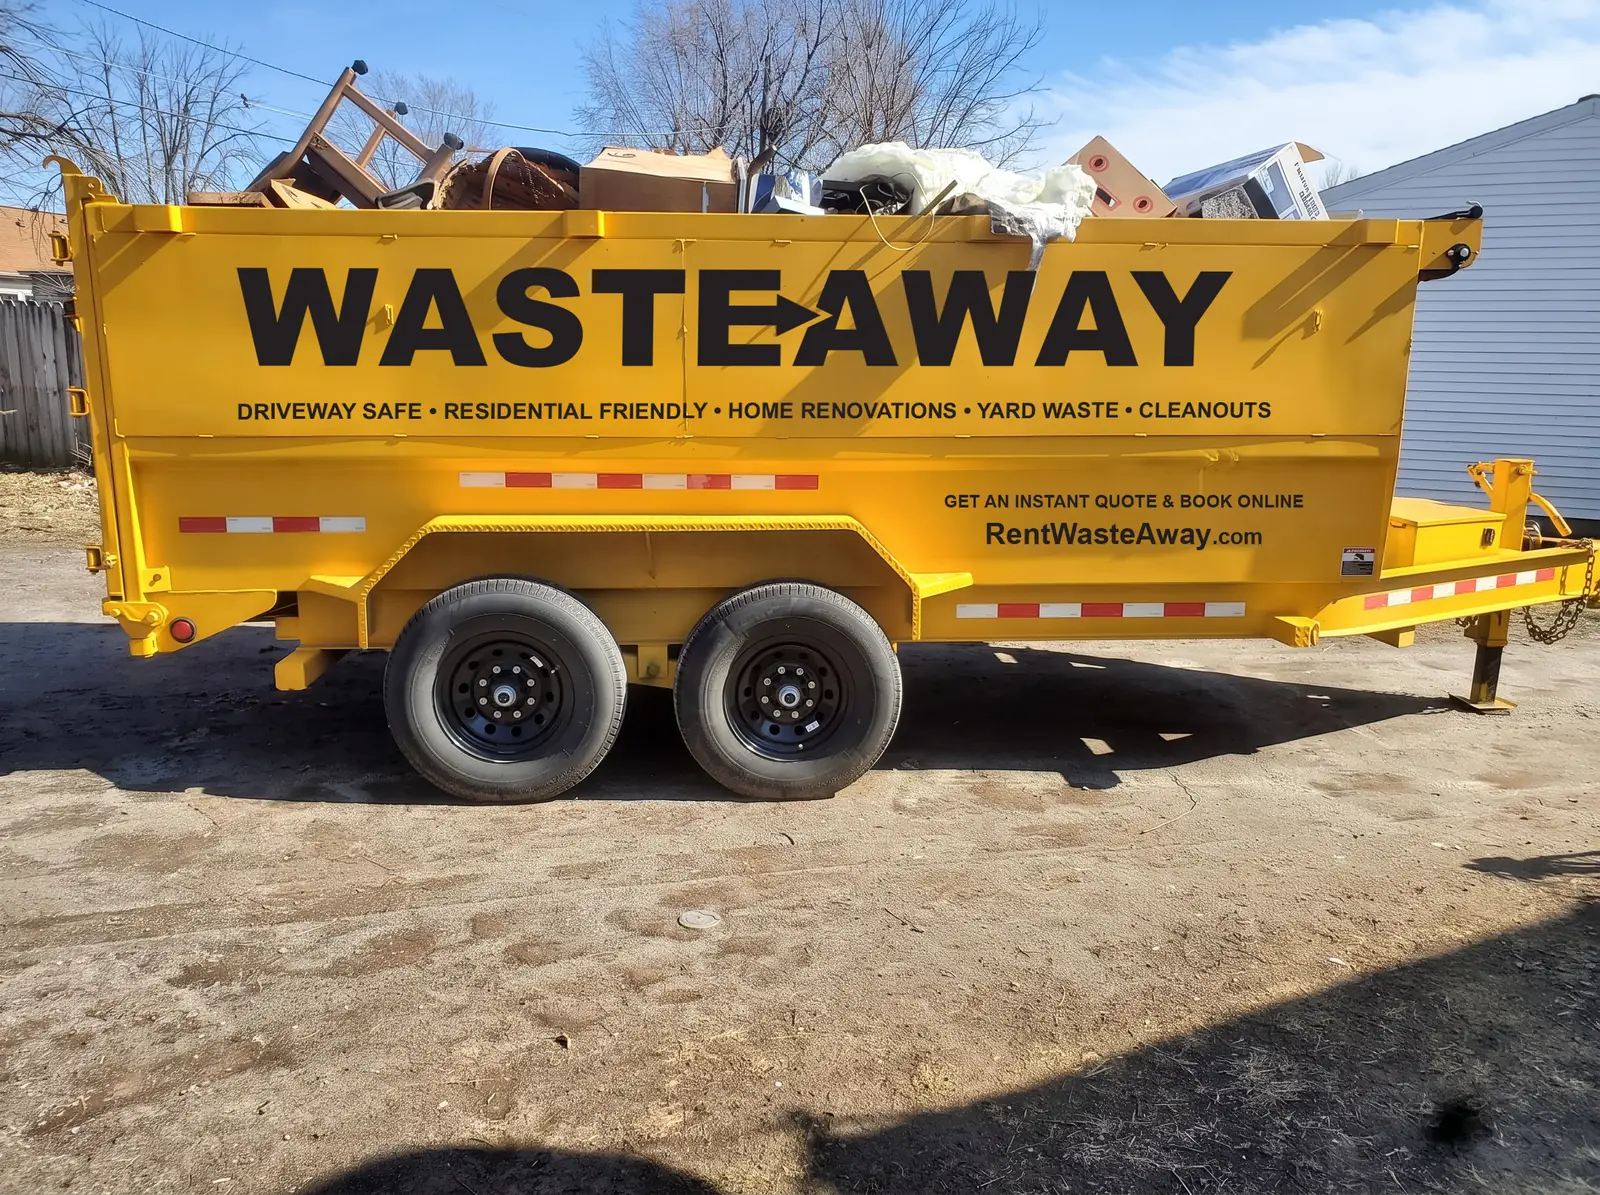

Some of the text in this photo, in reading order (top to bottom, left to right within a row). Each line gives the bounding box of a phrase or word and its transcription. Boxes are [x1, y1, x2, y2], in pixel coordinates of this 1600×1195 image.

[237, 267, 1233, 368] WASTEAWAY
[238, 401, 1271, 420] DRIVEWAY SAFE RESIDENTIAL FRIENDLY HOME RENOVATIONS YARD WASTE CLEANOUTS
[944, 494, 1304, 509] GET AN INSTANT QUOTE & BOOK ONLINE
[986, 522, 1262, 551] RentWasteAway.com
